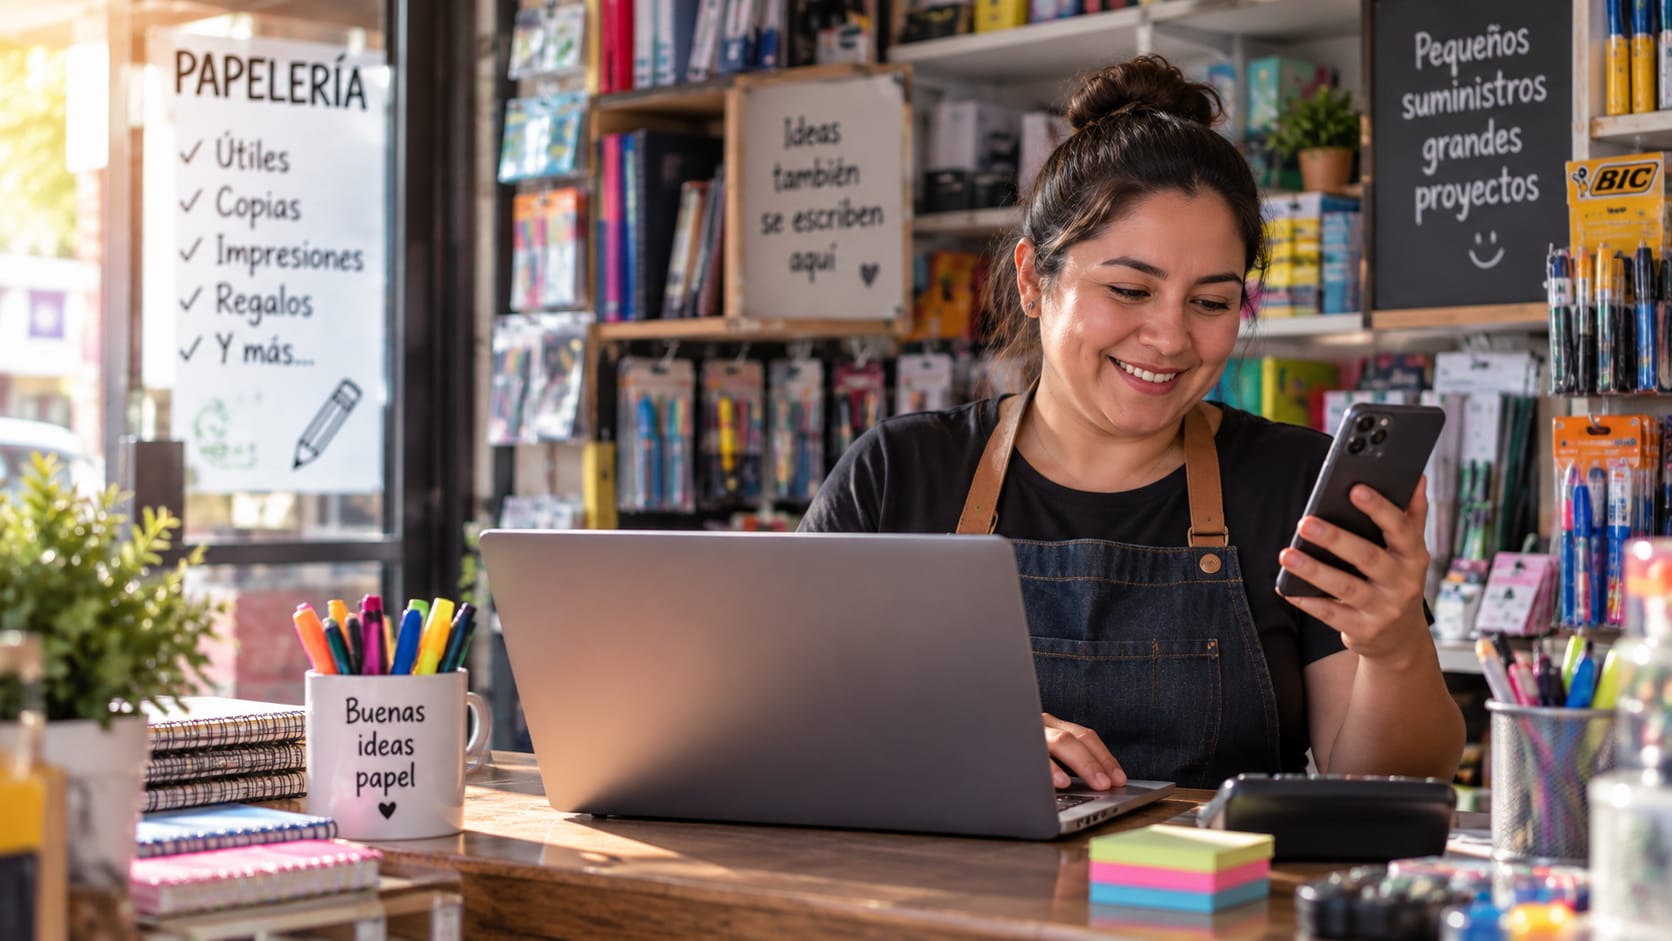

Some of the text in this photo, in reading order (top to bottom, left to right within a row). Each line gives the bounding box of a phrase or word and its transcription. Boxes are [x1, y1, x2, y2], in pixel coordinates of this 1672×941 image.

[1414, 24, 1530, 75] Pequeños
[175, 50, 367, 111] PAPELERÍA
[1402, 69, 1547, 121] suministros
[216, 131, 290, 174] Útiles
[784, 116, 841, 149] Ideas
[1422, 119, 1523, 176] grandes
[772, 157, 859, 192] también
[1595, 167, 1652, 191] BIC
[216, 185, 301, 229] Copias
[1415, 167, 1540, 225] proyectos
[761, 199, 884, 235] se escriben
[216, 234, 364, 276] Impresiones
[790, 242, 837, 282] aquí
[216, 284, 313, 327] Regalos
[215, 333, 315, 367] Y más...
[345, 696, 426, 725] Buenas
[357, 731, 415, 757] ideas
[356, 761, 416, 798] papel
